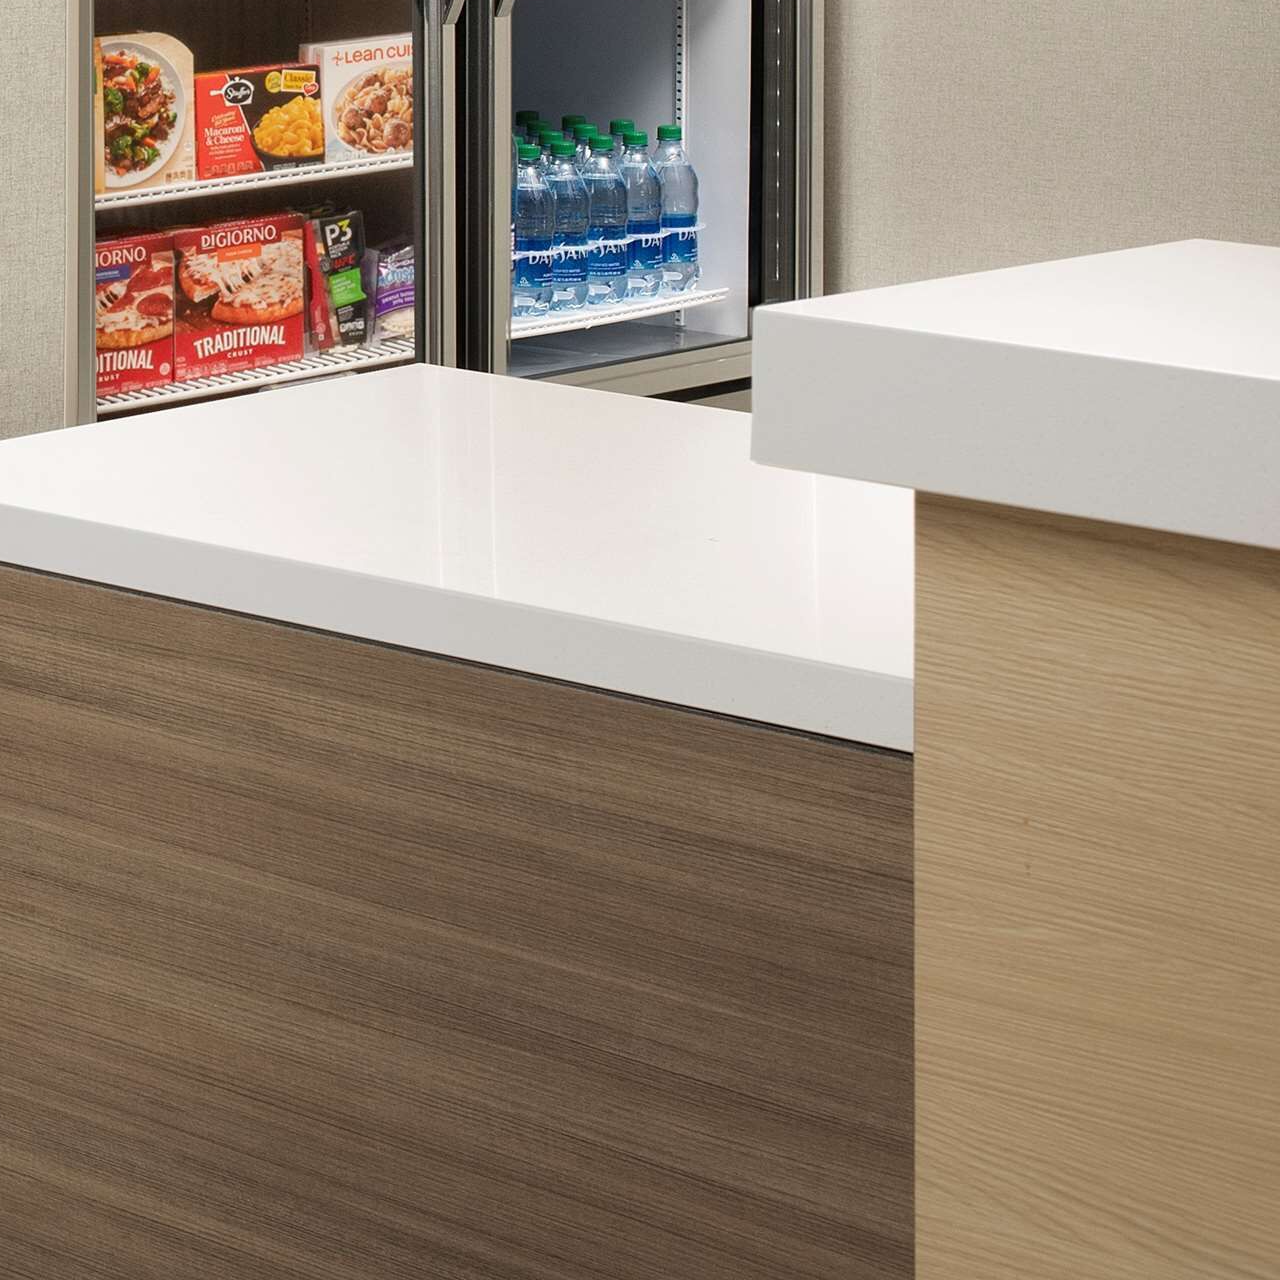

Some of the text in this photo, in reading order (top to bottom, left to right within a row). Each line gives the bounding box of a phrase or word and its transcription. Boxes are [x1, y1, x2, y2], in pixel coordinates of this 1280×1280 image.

[344, 46, 384, 64] Lean
[325, 219, 352, 247] P3
[193, 324, 286, 359] TRADITIONAL
[227, 348, 253, 359] CRUST
[98, 372, 120, 382] RUST
